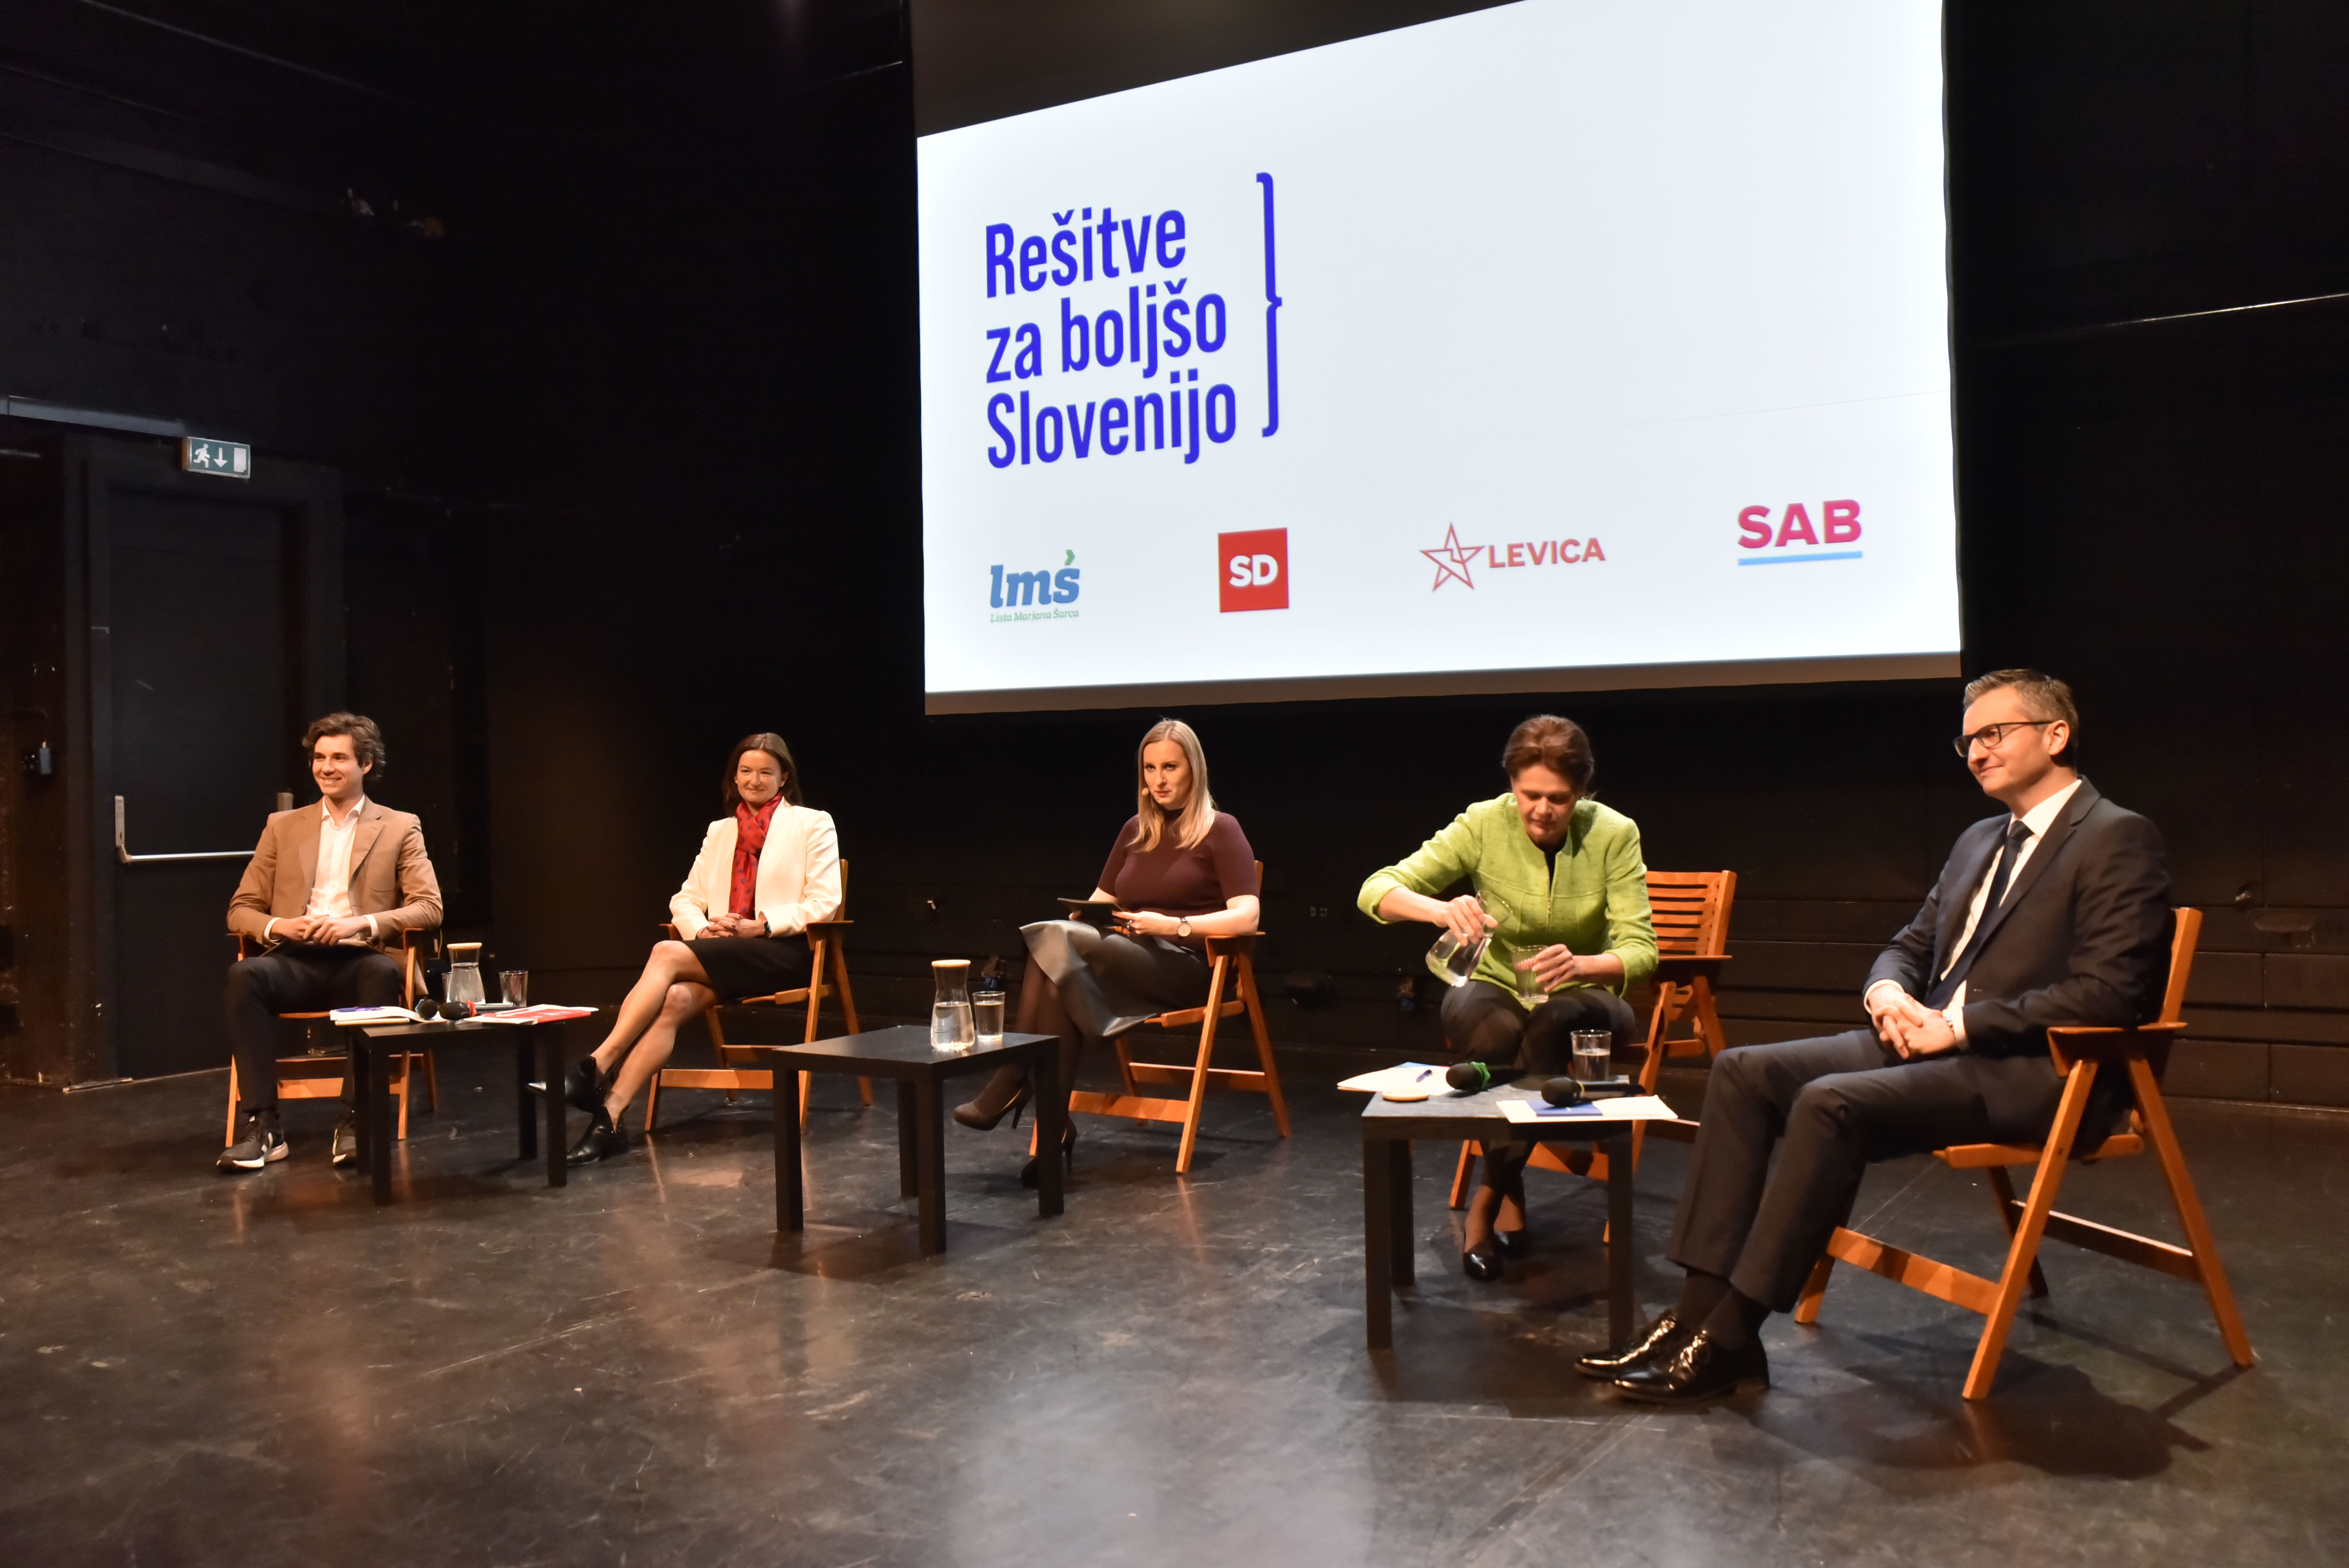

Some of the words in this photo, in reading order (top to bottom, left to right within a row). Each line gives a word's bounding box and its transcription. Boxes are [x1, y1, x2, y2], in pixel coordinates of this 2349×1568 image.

[986, 207, 1186, 298] Rešitve
[987, 322, 1043, 384] za
[1061, 278, 1227, 379] boljšo
[987, 368, 1237, 469] Slovenijo
[1738, 499, 1862, 549] SAB
[1229, 554, 1278, 588] SD
[1489, 538, 1606, 568] LEVICA
[990, 613, 1012, 623] Lista
[1014, 611, 1052, 621] Marjana
[1053, 608, 1079, 618] Šarca
